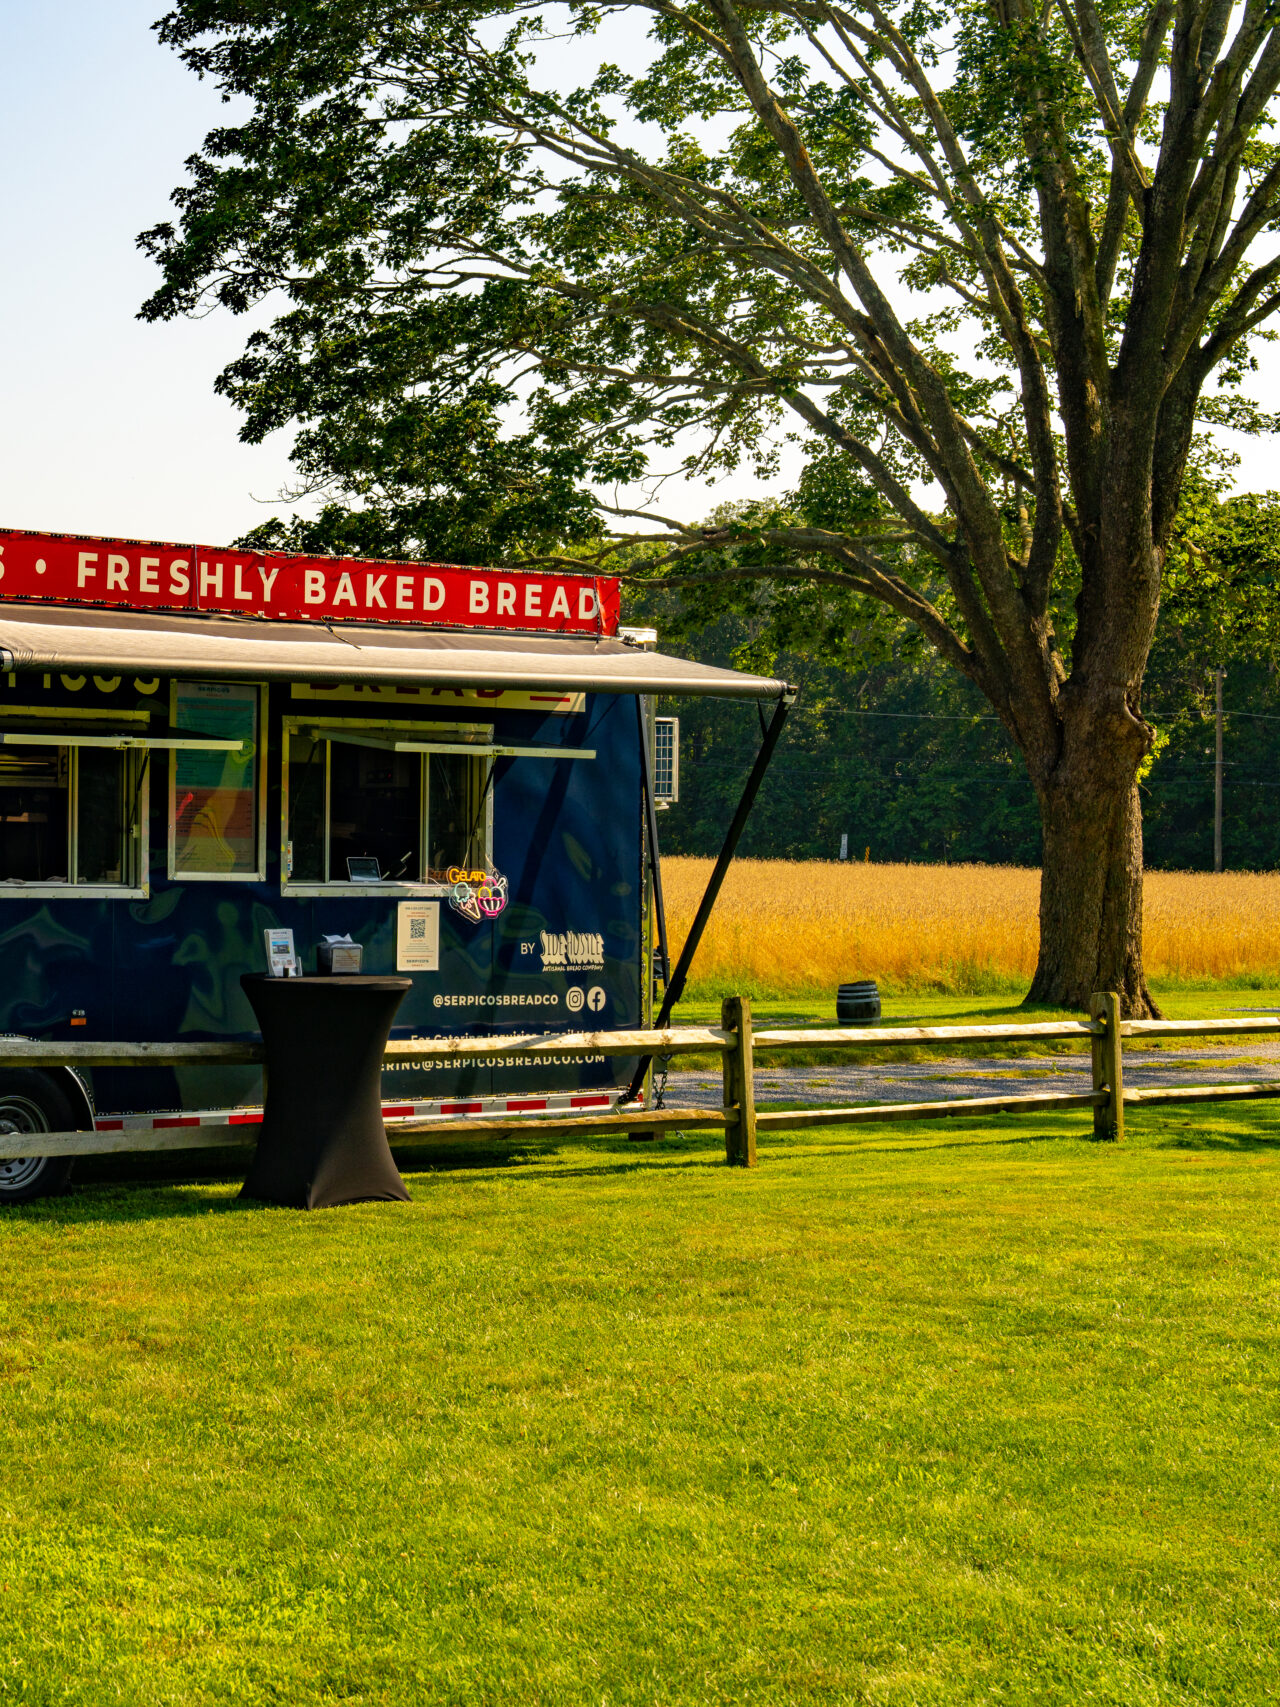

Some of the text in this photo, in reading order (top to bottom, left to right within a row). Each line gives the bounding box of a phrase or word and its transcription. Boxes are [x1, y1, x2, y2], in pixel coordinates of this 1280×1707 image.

[77, 551, 280, 602] FRESHLY
[304, 569, 446, 611] BAKED
[469, 580, 602, 620] BREAD
[449, 868, 487, 883] GELATO
[520, 942, 535, 955] BY
[582, 964, 604, 972] COMPANY
[433, 994, 559, 1008] @SERPICOSBREADCO
